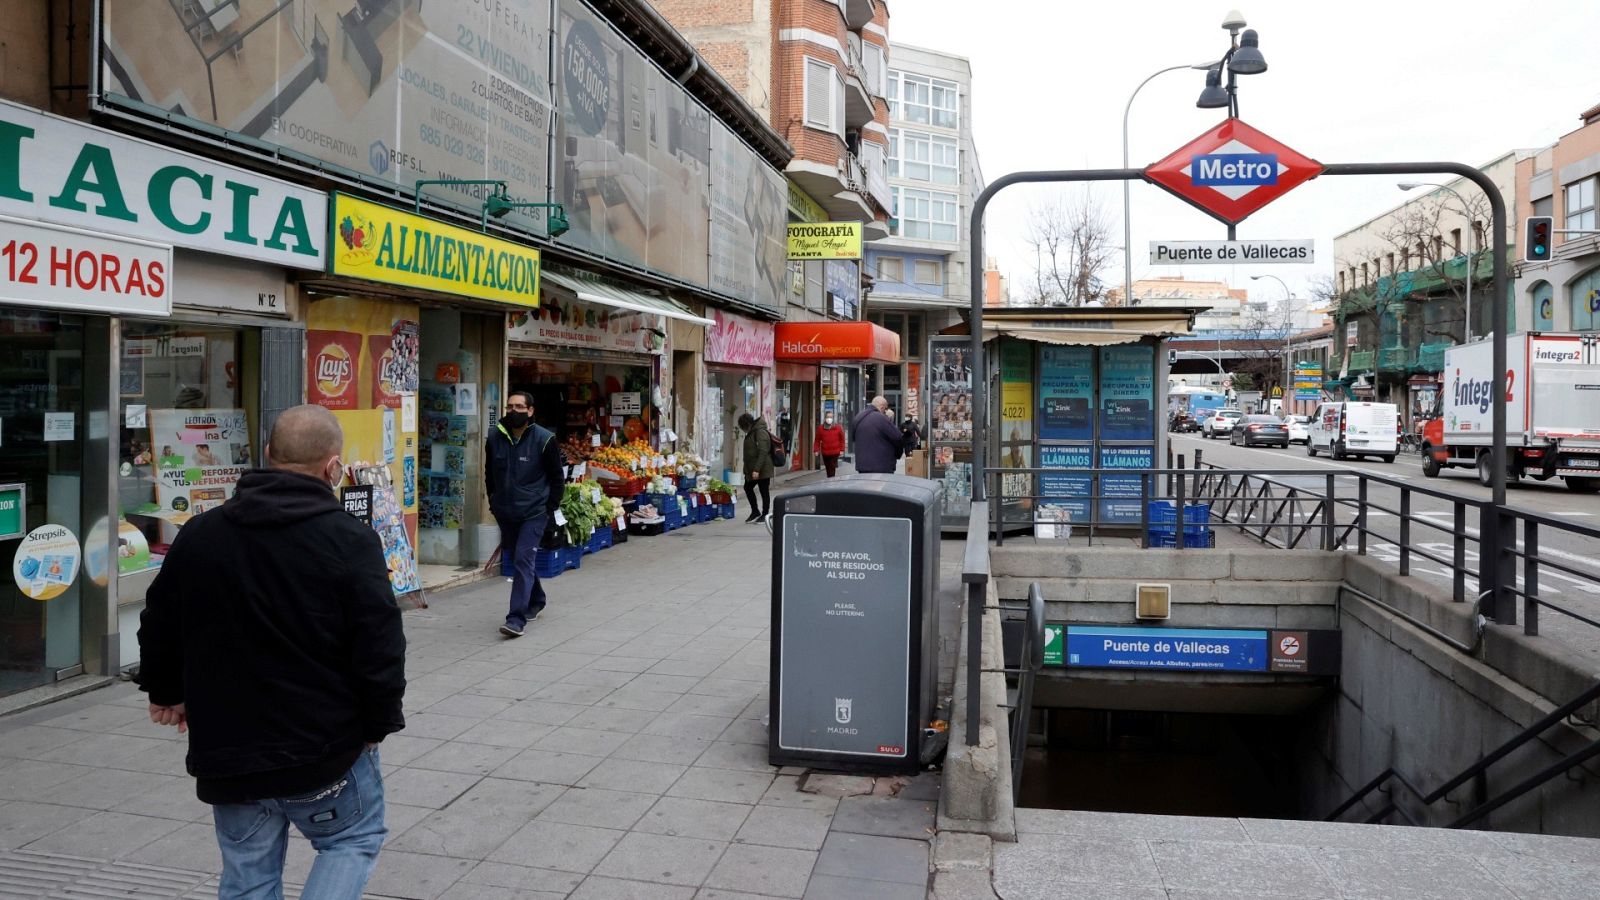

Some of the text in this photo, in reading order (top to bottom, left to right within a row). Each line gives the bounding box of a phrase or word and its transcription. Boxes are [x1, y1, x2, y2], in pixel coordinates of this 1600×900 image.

[457, 23, 474, 53] 22
[497, 79, 544, 115] DORMITORIOS
[289, 122, 358, 160] COOPERATIVA
[390, 149, 427, 174] RDF S.L.
[1200, 158, 1271, 180] Metro
[787, 224, 854, 238] FOTOGRAFÍA
[792, 239, 819, 250] Miguel
[375, 221, 538, 295] ALIMENTACION
[1158, 244, 1307, 260] Puente de Vallecas
[1, 240, 165, 298] 12 HORAS
[268, 294, 276, 307] 12
[1536, 347, 1581, 362] integra2
[318, 355, 350, 387] Lay's
[1042, 453, 1090, 466] LLÁMANOS
[1102, 455, 1150, 467] LLÁMANOS
[173, 479, 190, 487] TUS
[345, 491, 368, 500] BEBIDAS
[344, 499, 367, 511] FRÍAS
[29, 529, 66, 541] Strepsils
[822, 551, 871, 562] POR FAVOR,
[808, 561, 884, 571] NO TIRE RESIDUOS
[827, 571, 865, 580] AL SUELO
[1104, 639, 1230, 655] Puente de Vallecas
[827, 726, 858, 735] MADRID
[880, 746, 900, 754] SULO
